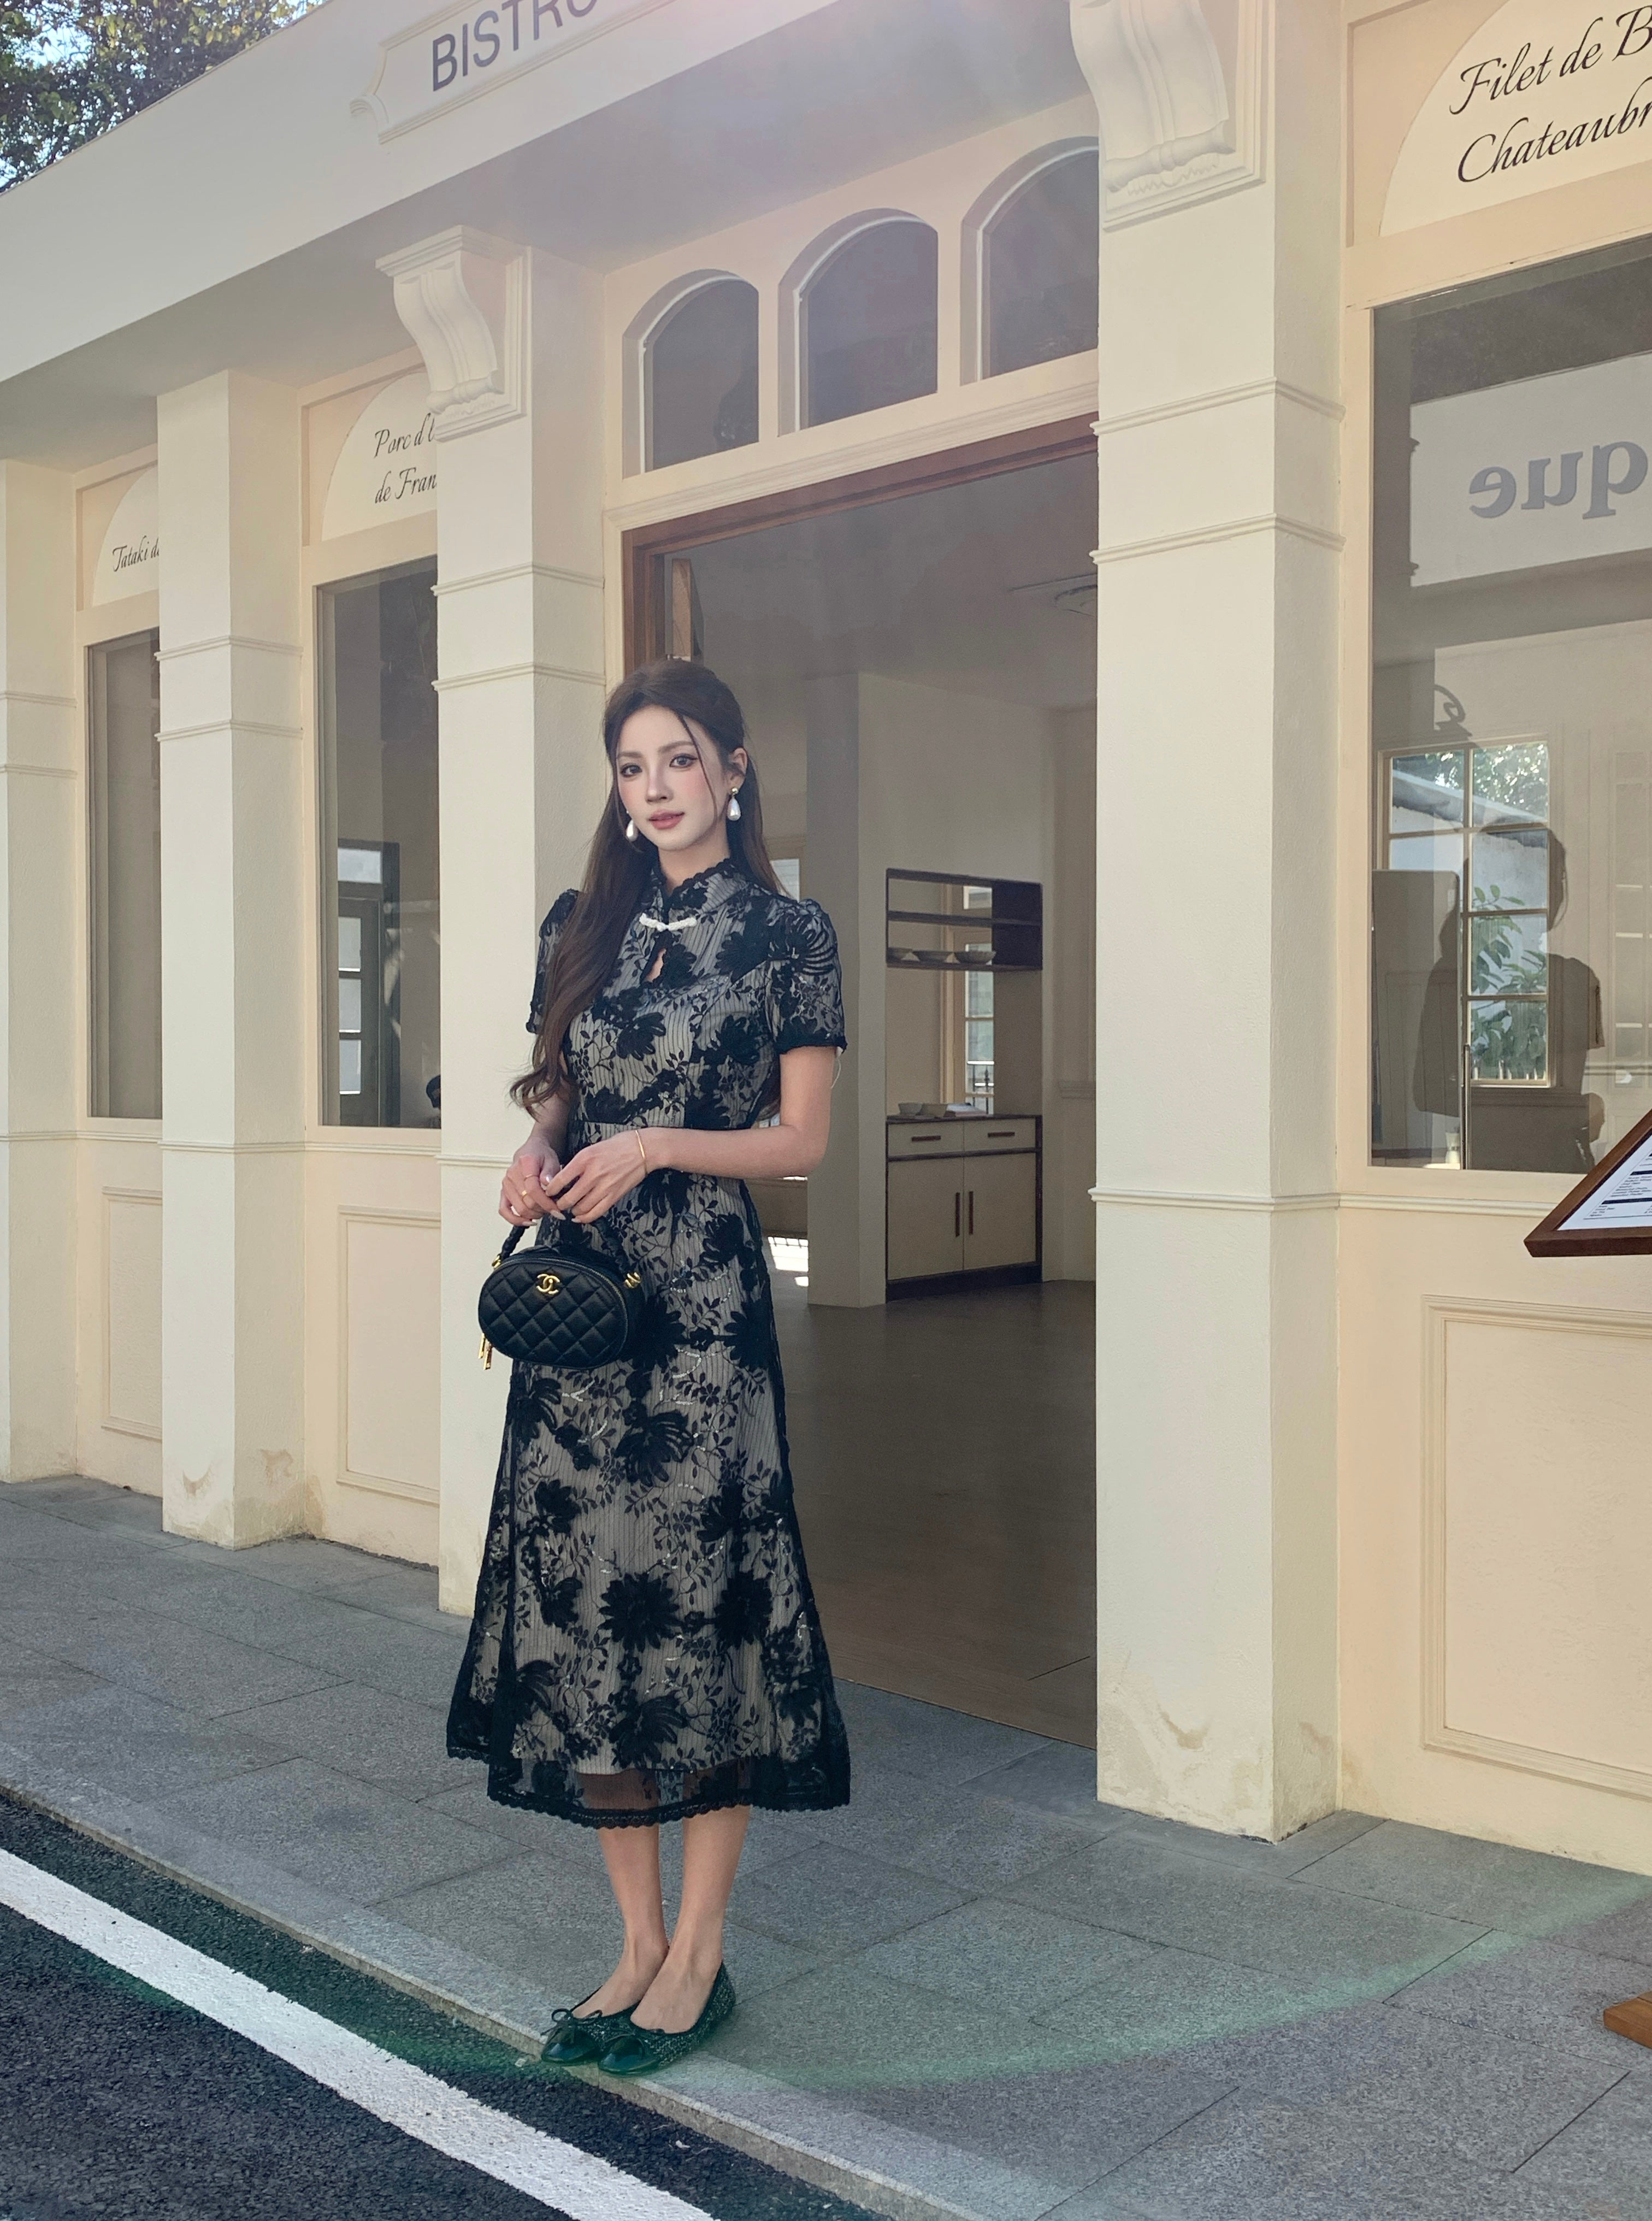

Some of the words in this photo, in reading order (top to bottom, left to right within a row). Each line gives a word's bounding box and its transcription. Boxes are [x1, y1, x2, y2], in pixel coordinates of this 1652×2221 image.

[1449, 42, 1554, 115] Filet
[1559, 17, 1603, 77] de
[1612, 5, 1652, 61] B
[375, 470, 391, 504] de
[395, 467, 437, 499] Fran
[113, 535, 150, 572] Tataki
